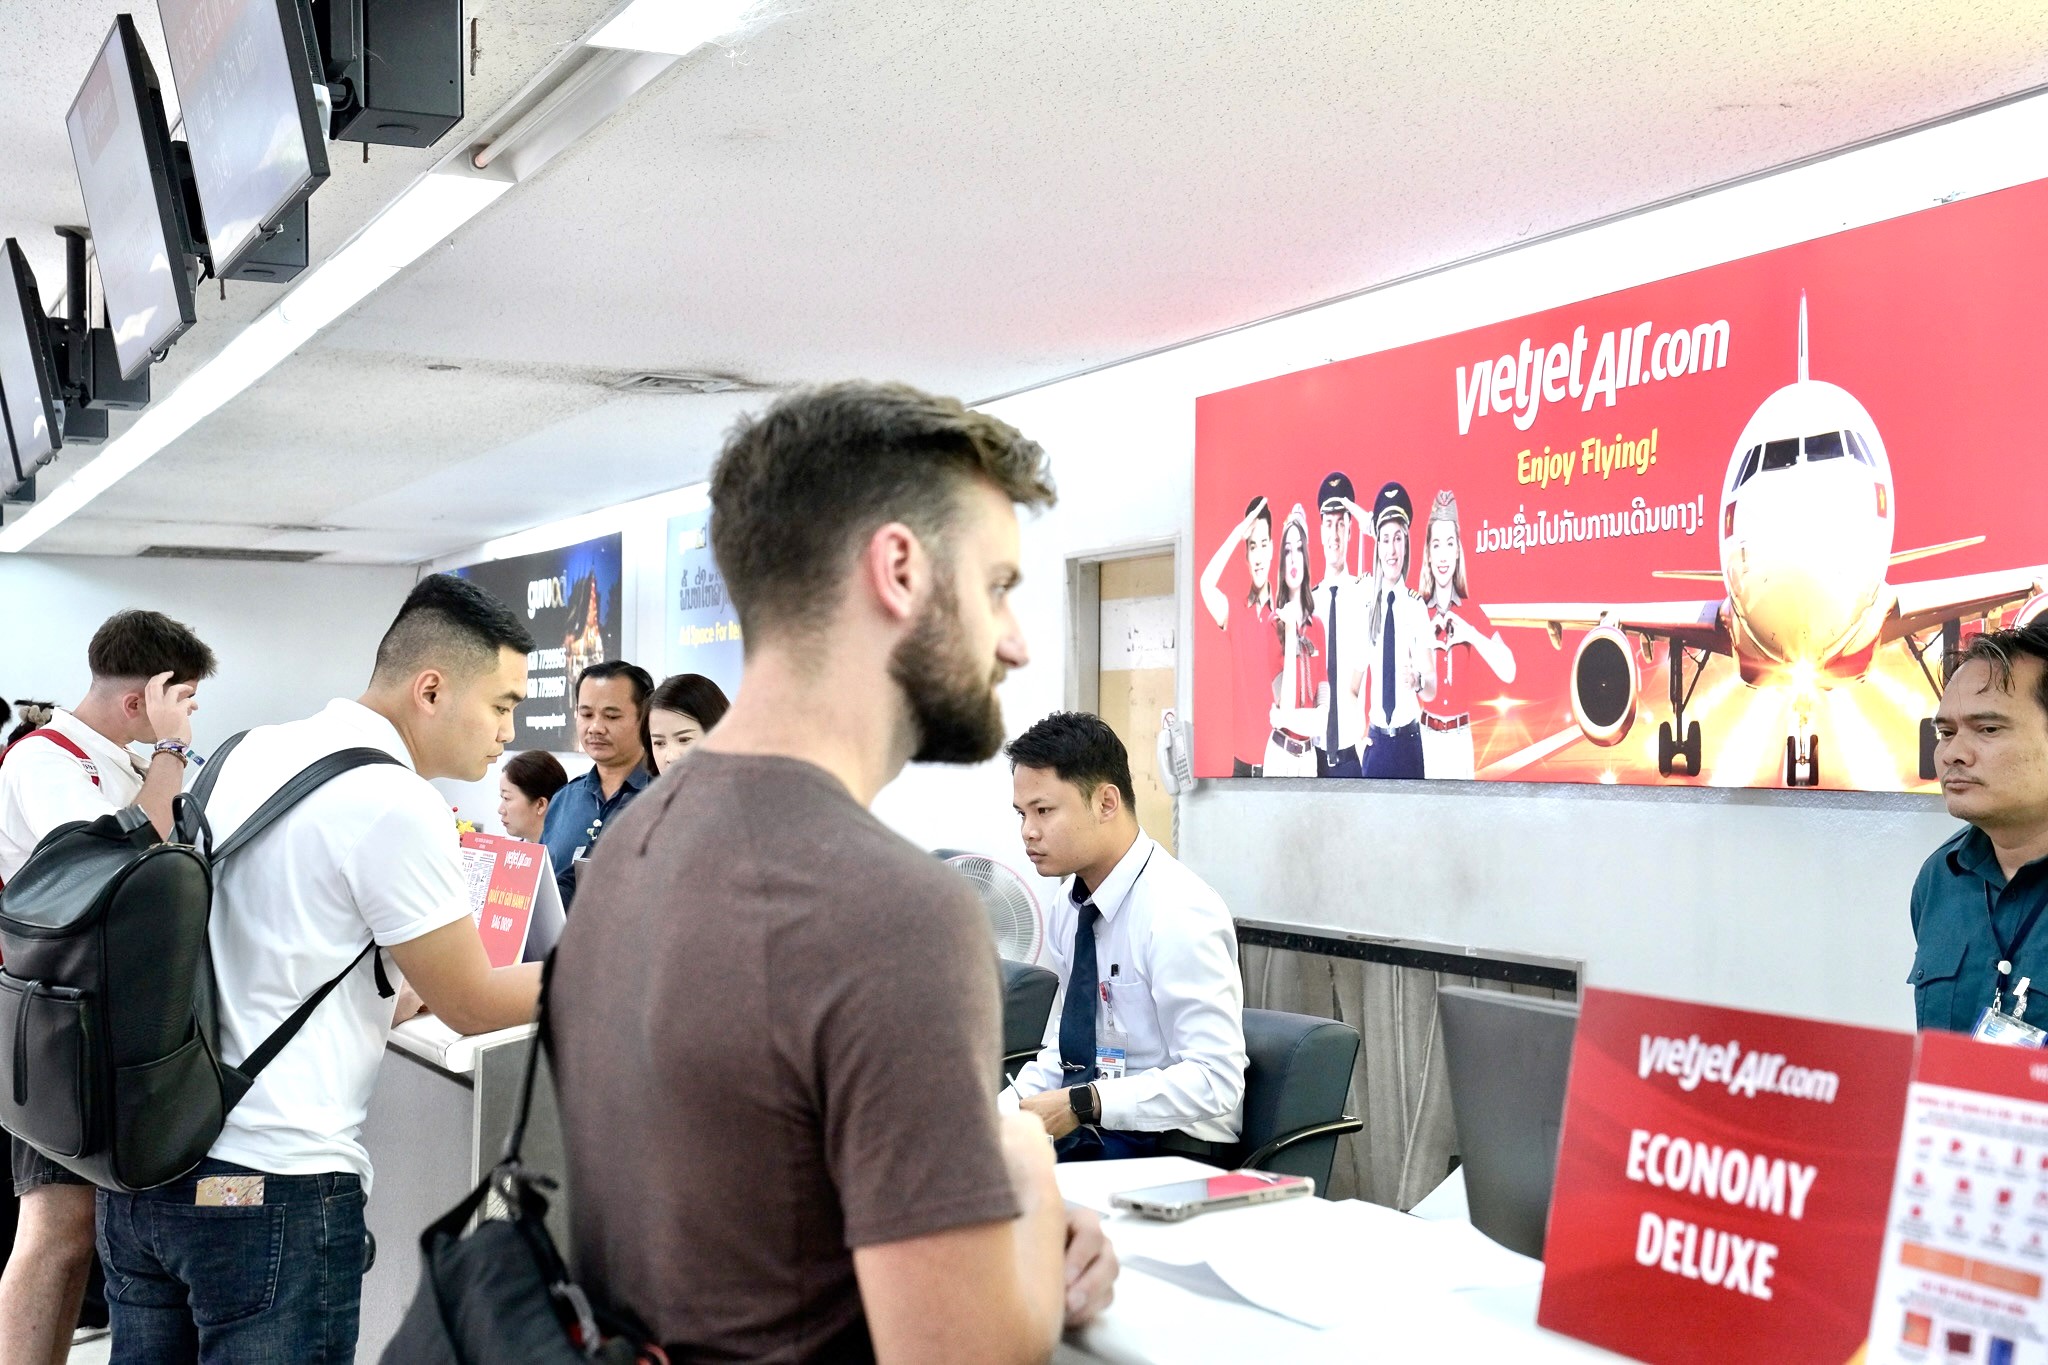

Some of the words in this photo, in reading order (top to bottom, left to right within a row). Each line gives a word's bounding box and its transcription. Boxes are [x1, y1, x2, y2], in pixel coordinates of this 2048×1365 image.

[1517, 446, 1576, 490] Enjoy
[1581, 428, 1658, 480] Flying!
[715, 621, 728, 642] For
[1626, 1129, 1818, 1220] ECONOMY
[1635, 1211, 1779, 1301] DELUXE
